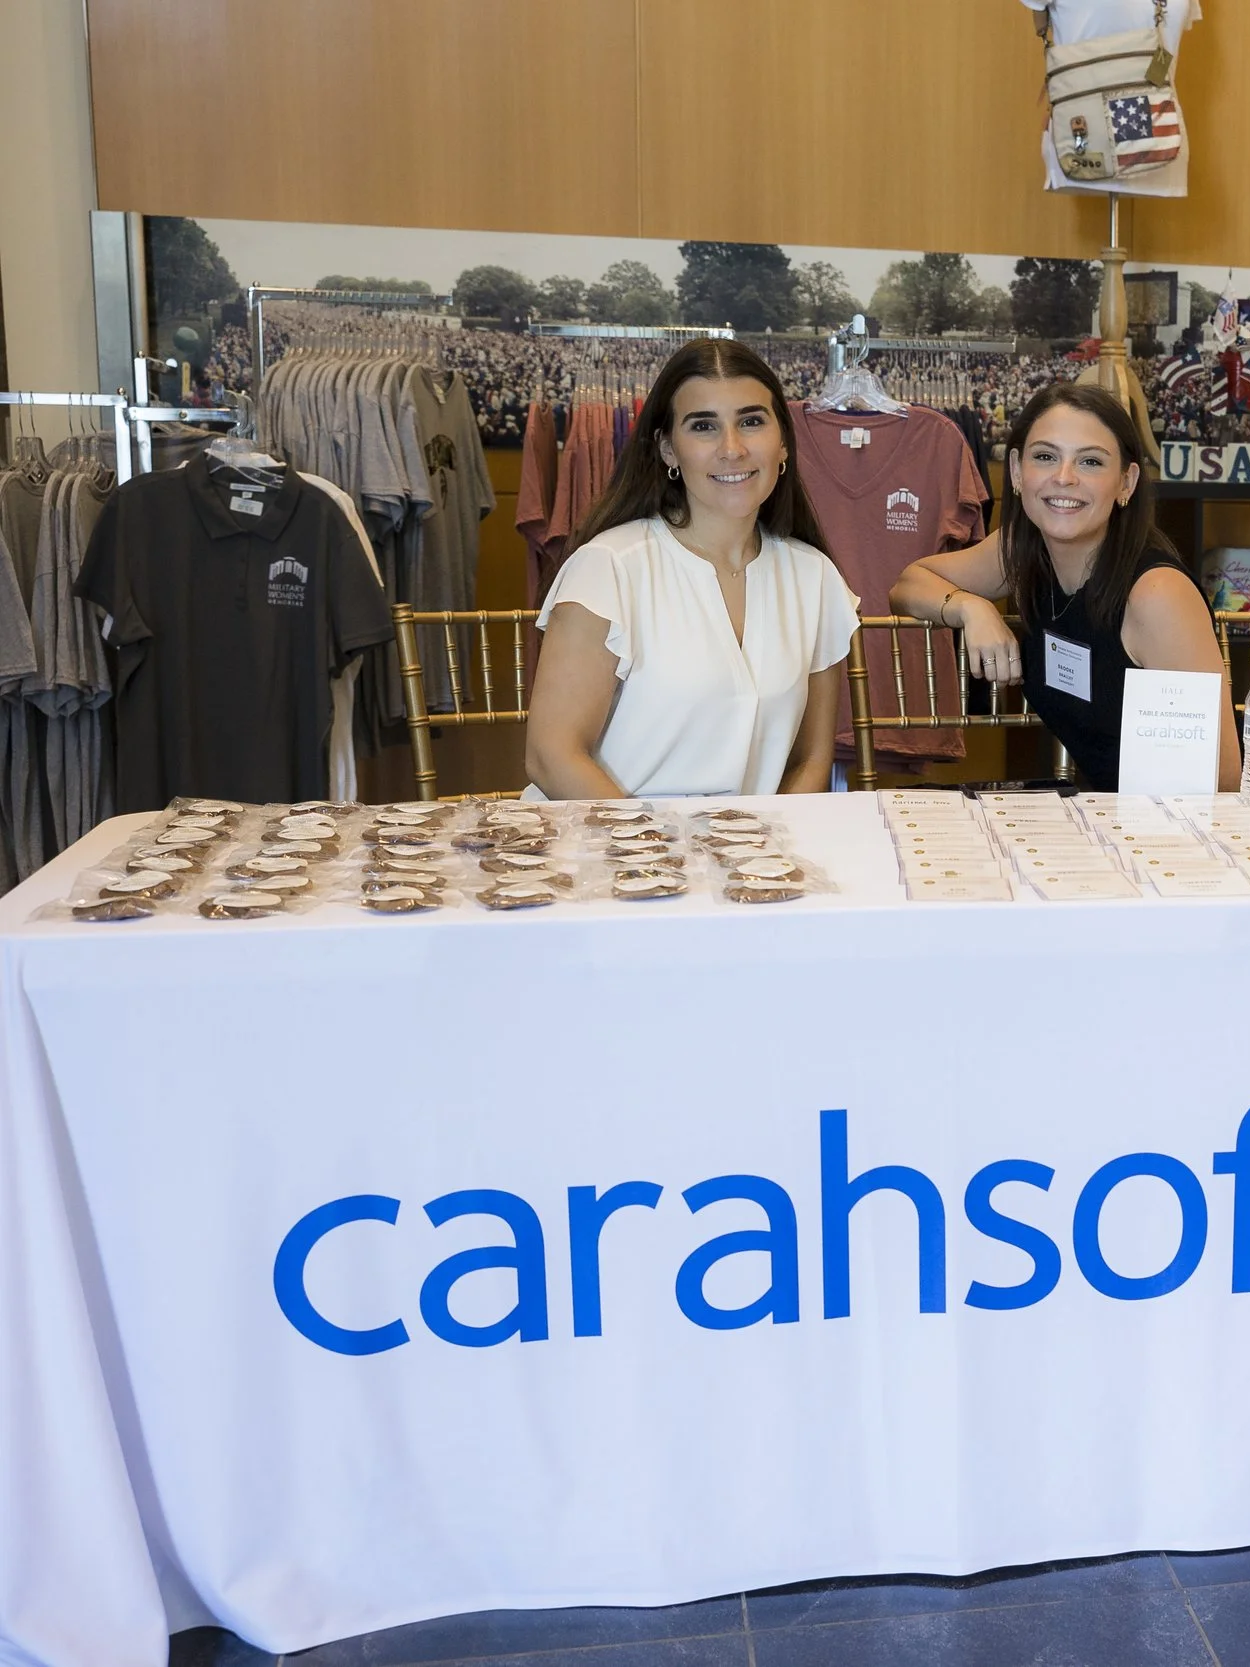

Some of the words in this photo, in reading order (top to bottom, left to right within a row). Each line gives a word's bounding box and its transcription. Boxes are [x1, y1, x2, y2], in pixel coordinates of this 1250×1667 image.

[886, 511, 919, 521] MILITARY
[886, 518, 919, 528] WOMEN'S
[886, 525, 919, 533] MEMORIAL
[267, 583, 306, 592] MILITARY
[1138, 709, 1159, 717] TABLE
[1160, 711, 1206, 720] ASSIGNMENTS
[1136, 722, 1206, 741] carahsoft
